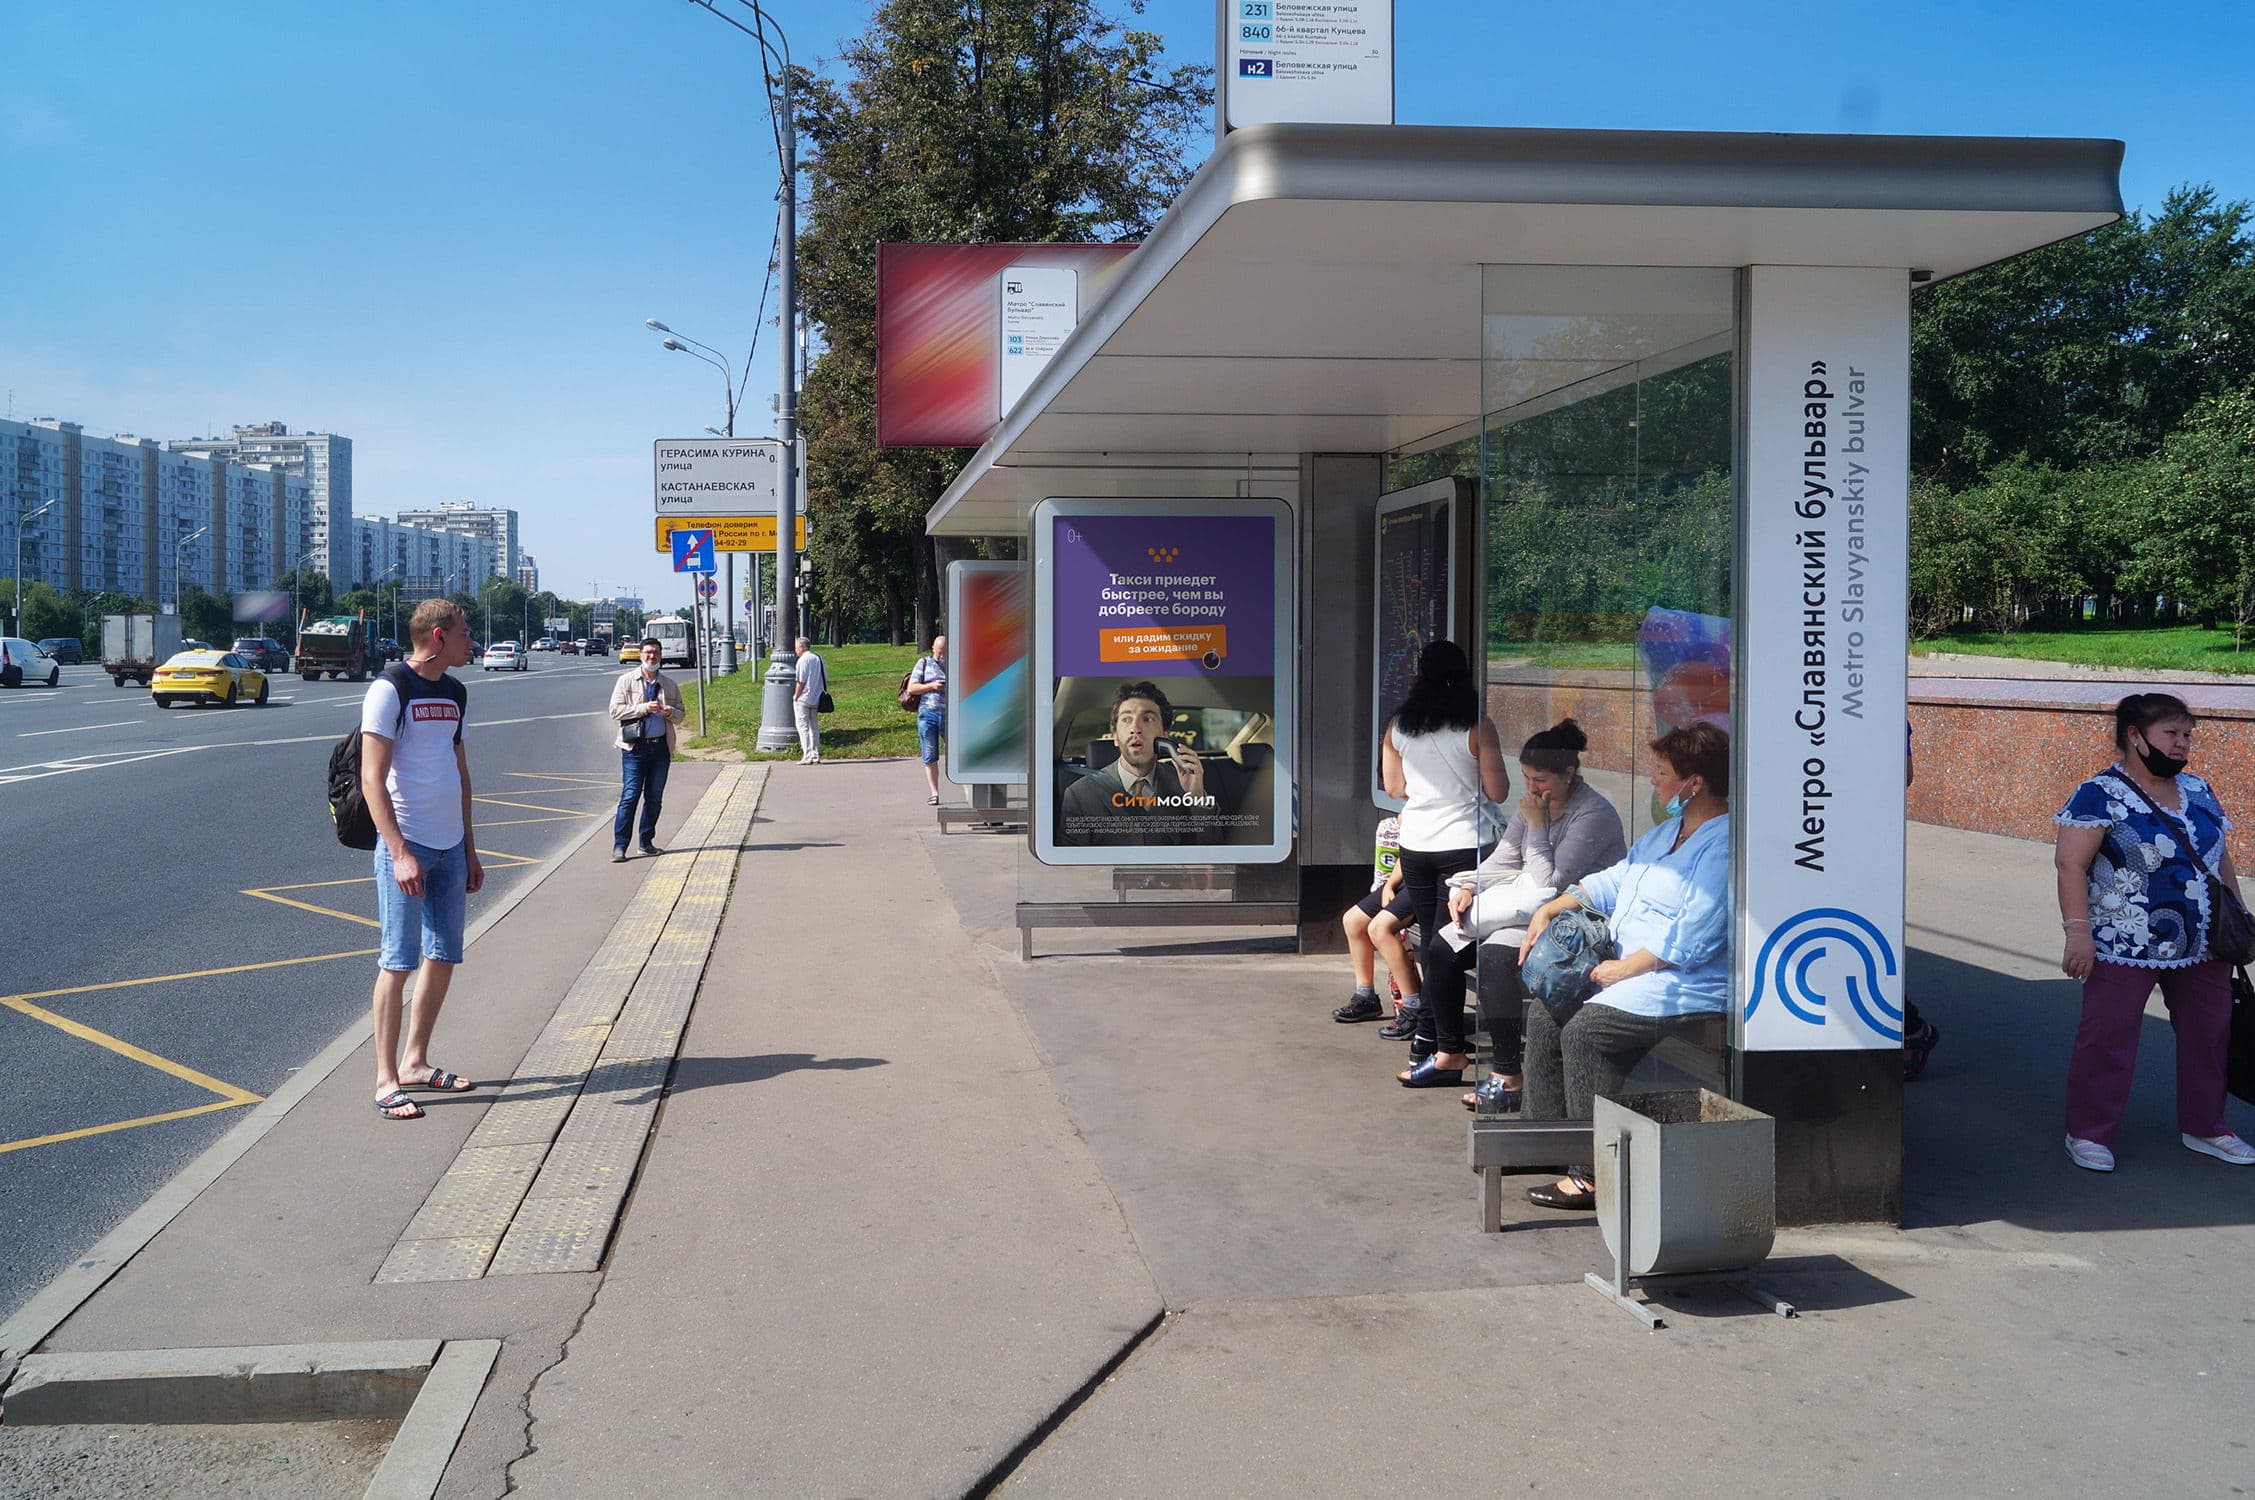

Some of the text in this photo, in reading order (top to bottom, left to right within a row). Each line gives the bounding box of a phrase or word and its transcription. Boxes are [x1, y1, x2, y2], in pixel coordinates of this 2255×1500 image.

[1245, 3, 1267, 16] 231
[1275, 2, 1358, 13] Беловежская улица
[1242, 26, 1270, 39] 840
[1275, 24, 1366, 36] 66-й квартал Кунцева
[1275, 60, 1358, 72] Беловежская улица
[1009, 335, 1022, 344] 103
[1009, 346, 1022, 354] 622
[660, 448, 766, 459] ГЕРАСИМА КУРИНА
[769, 454, 778, 464] 0.
[660, 461, 693, 471] улица
[661, 481, 755, 492] КАСТАНАЕВСКАЯ
[770, 487, 778, 497] 1.
[661, 495, 693, 505] улица
[687, 521, 759, 530] Телефон доверия
[1066, 528, 1083, 544] 0+
[1841, 366, 1870, 720] Metro Slavyanskiy bulvar
[1109, 573, 1217, 588] Такси приедет
[1101, 587, 1224, 602] быстрее, чем вы
[1098, 602, 1226, 618] добреете бороду
[1794, 360, 1835, 873] Метро «Славянский бульвар»
[1113, 631, 1212, 644] или дадим скидку
[1128, 643, 1198, 655] за ожидание
[415, 706, 430, 719] AND
[1111, 791, 1216, 808] Ситимобил
